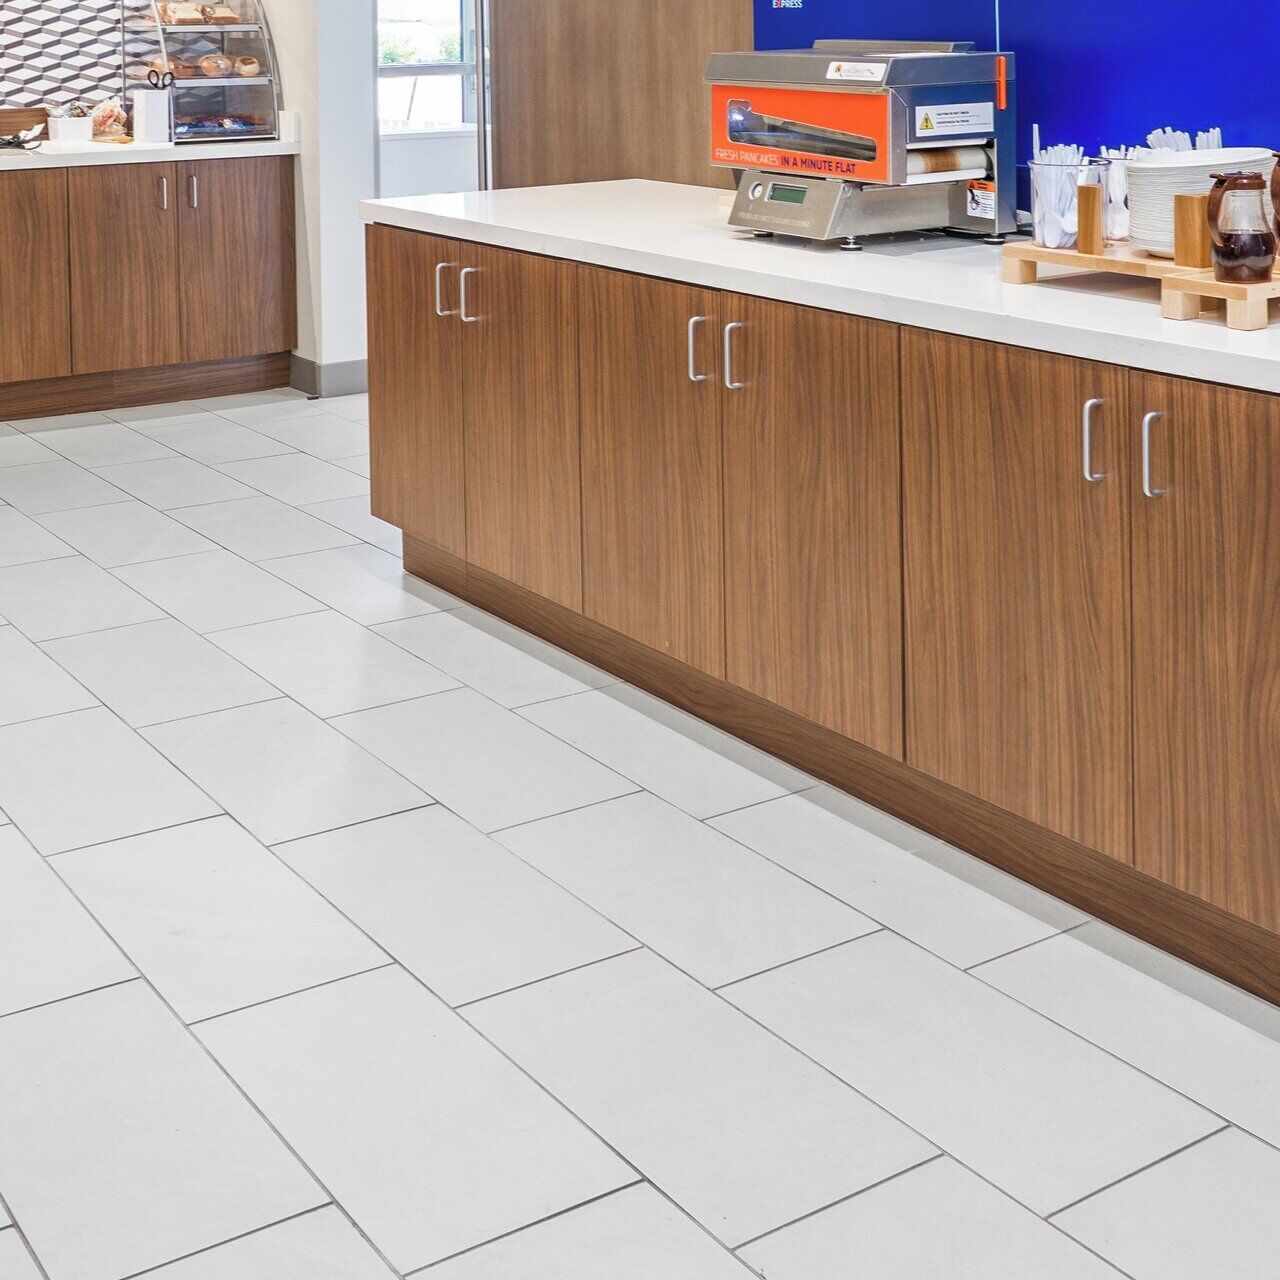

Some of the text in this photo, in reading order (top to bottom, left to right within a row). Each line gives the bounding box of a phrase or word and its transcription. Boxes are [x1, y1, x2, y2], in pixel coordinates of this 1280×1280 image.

[772, 0, 803, 9] EXPRESS
[715, 148, 856, 174] FRESH PANCAKES IN A MINUTE FLAT
